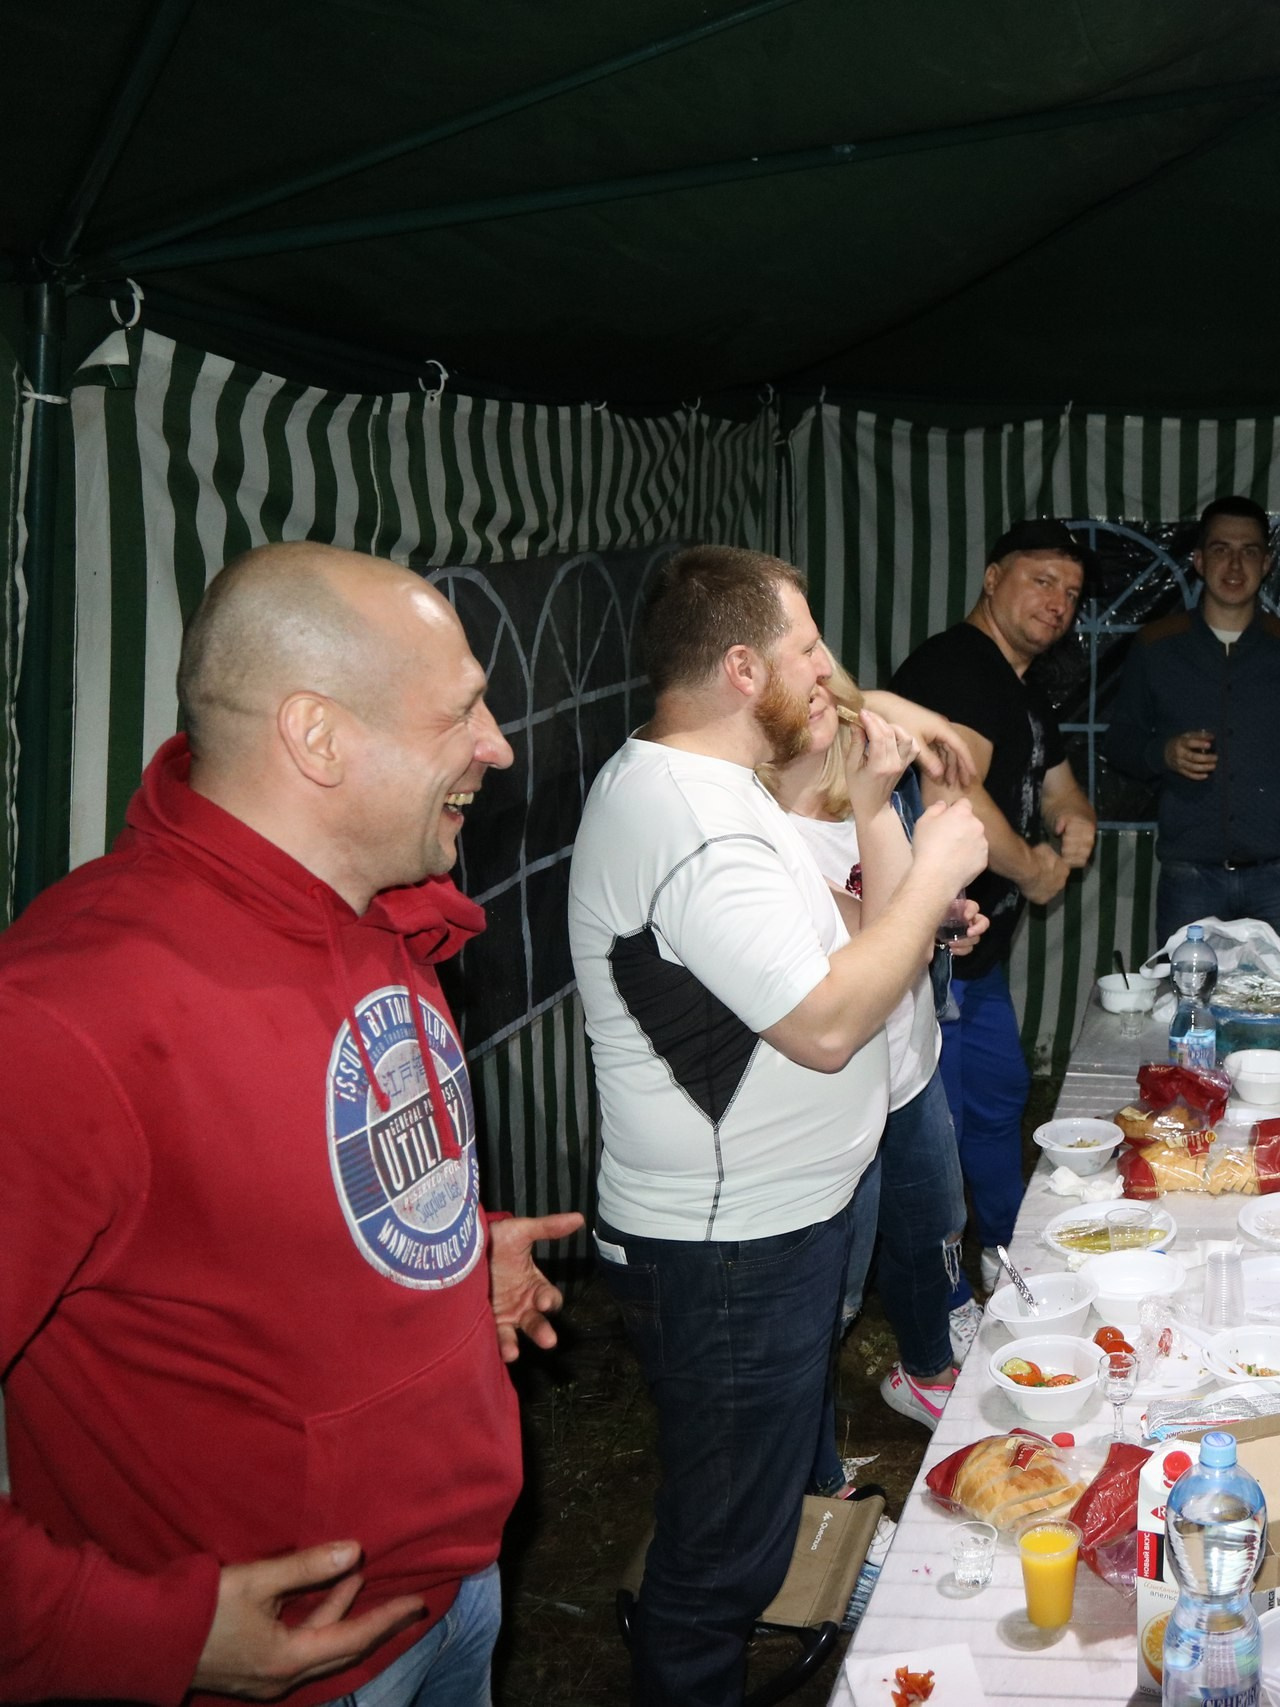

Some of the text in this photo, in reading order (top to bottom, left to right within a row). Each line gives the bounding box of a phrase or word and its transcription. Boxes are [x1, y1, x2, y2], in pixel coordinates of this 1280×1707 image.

[364, 1003, 387, 1038] BY
[386, 997, 412, 1026] TOM
[389, 1104, 423, 1136] GENERAL
[378, 1099, 462, 1191] UTILIY
[377, 1218, 461, 1270] MANUFACTURED
